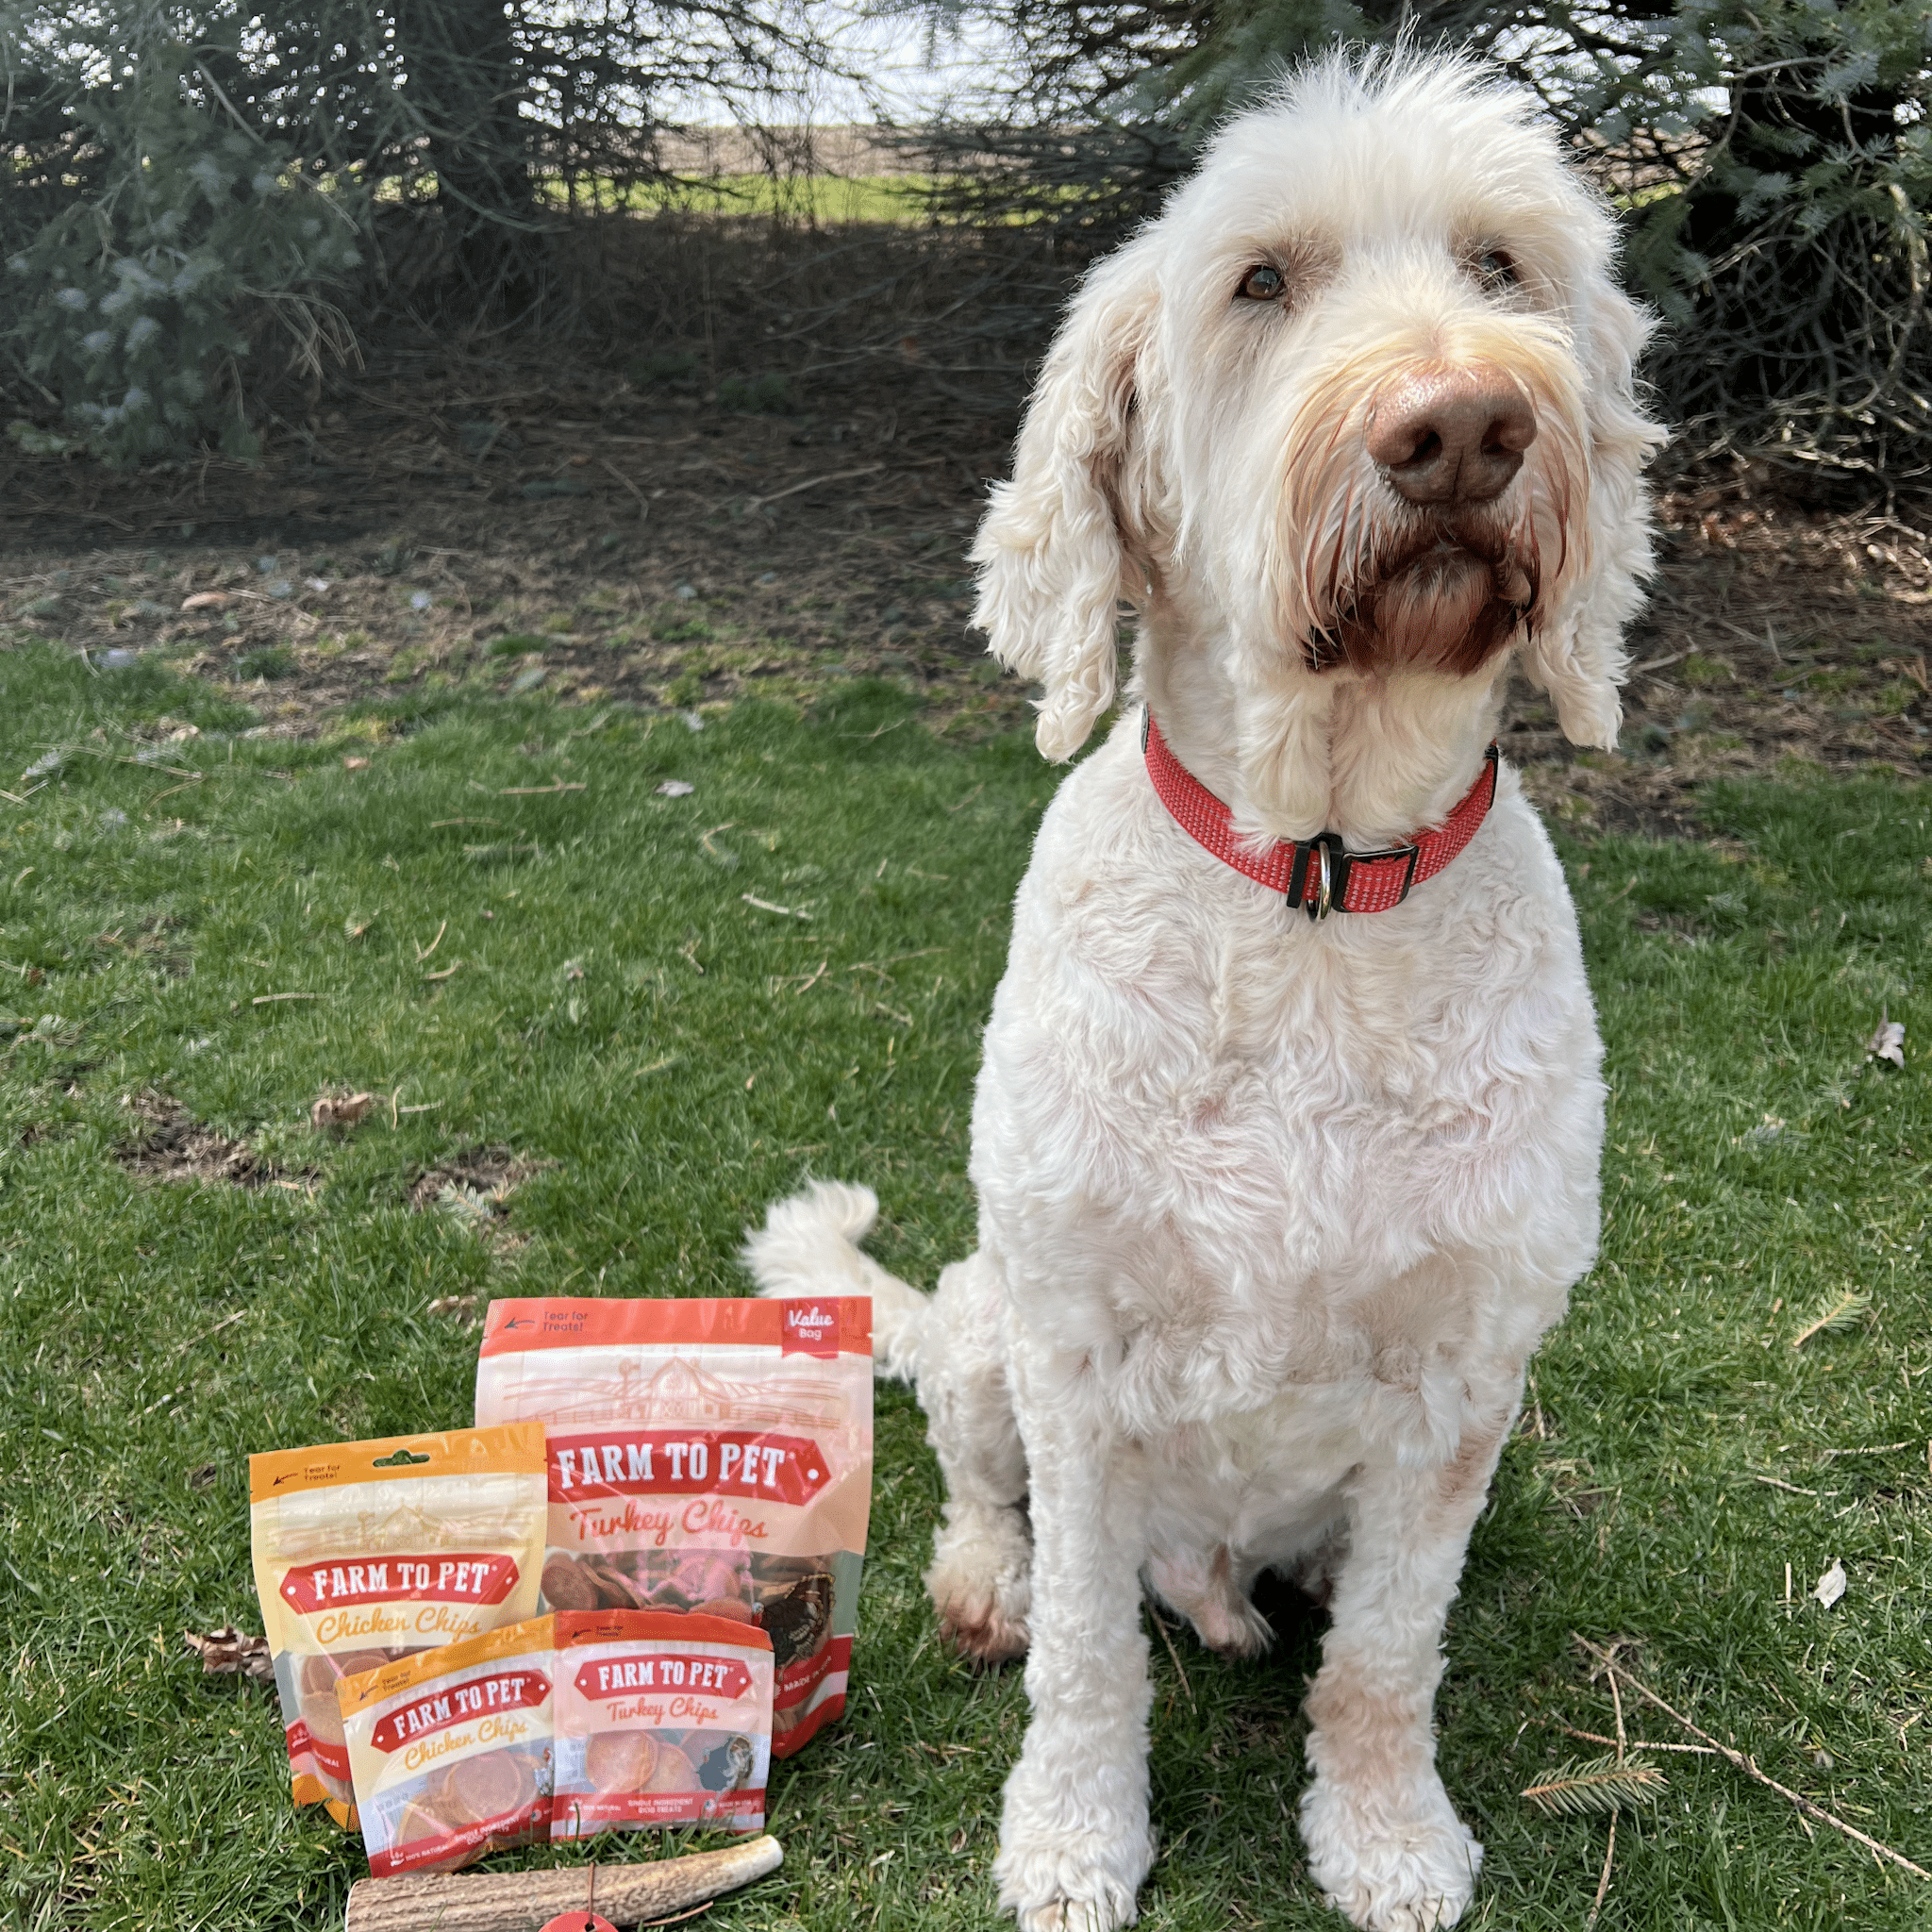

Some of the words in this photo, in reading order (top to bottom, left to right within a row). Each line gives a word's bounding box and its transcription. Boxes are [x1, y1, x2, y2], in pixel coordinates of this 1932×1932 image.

[543, 1322, 583, 1331] Treats!
[544, 1311, 569, 1321] Tear
[572, 1310, 589, 1321] for
[789, 1307, 835, 1327] Value
[799, 1327, 822, 1341] Bag
[557, 1442, 655, 1490] FARM
[664, 1442, 708, 1480] TO
[719, 1442, 786, 1488] PET
[569, 1498, 675, 1546] Turkey
[681, 1499, 769, 1546] Chips
[312, 1562, 389, 1601] FARM
[397, 1562, 430, 1590] TO
[438, 1561, 490, 1594] PET
[316, 1607, 411, 1645] Chicken
[415, 1606, 481, 1644] Chips
[597, 1661, 655, 1691] FARM
[659, 1660, 686, 1686] TO
[689, 1660, 728, 1689] PET
[393, 1701, 452, 1740] FARM
[455, 1686, 483, 1714] TO
[485, 1677, 526, 1707] PET
[607, 1696, 666, 1725] Turkey
[669, 1696, 719, 1725] Chips
[405, 1731, 476, 1771] Chicken
[477, 1716, 528, 1744] Chips
